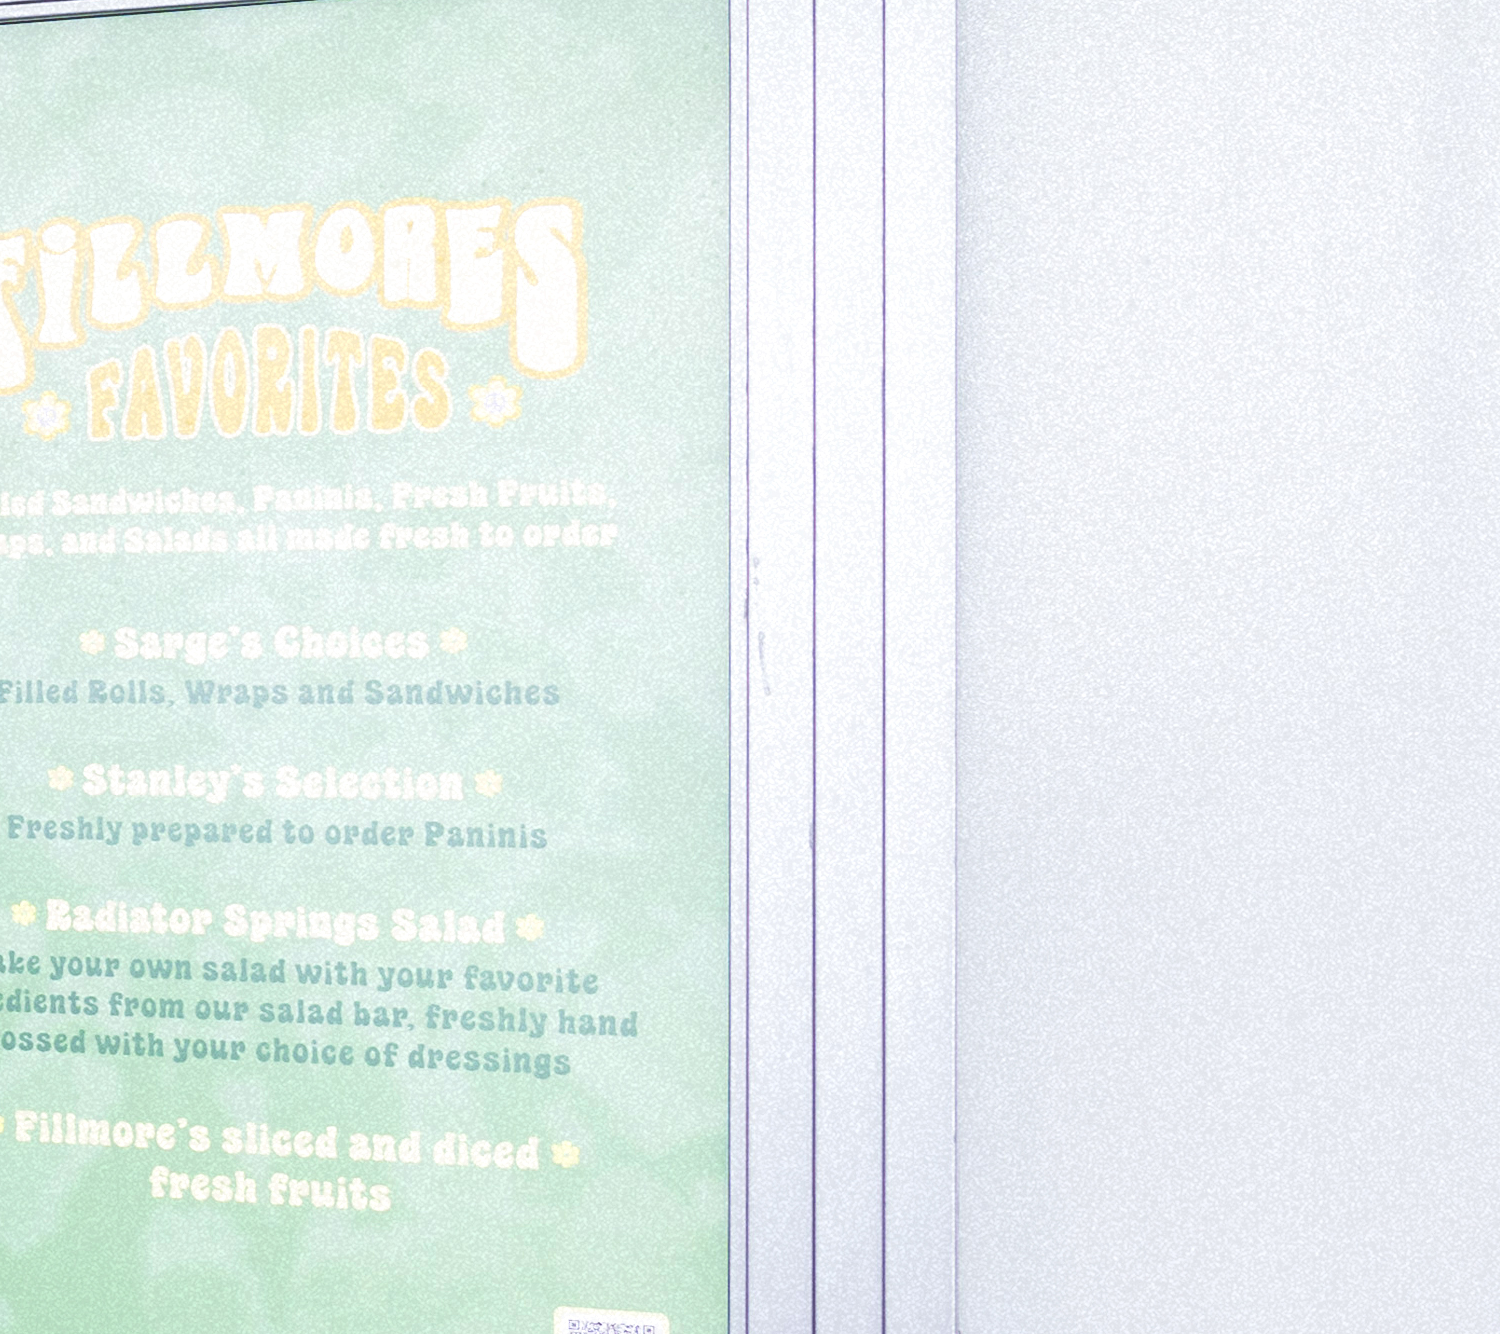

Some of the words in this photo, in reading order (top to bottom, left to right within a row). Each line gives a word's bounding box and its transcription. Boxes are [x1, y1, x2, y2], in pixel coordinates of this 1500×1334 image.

[85, 322, 453, 442] FAVORITES
[392, 481, 488, 509] Fresh
[61, 528, 115, 554] and
[124, 525, 228, 553] Salads
[236, 524, 277, 552] all
[286, 524, 370, 551] made
[379, 522, 469, 549] fresh
[479, 521, 514, 547] to
[522, 519, 619, 548] order
[113, 625, 262, 664] Sarge's
[273, 625, 429, 659] Choices
[87, 679, 176, 708] Rolls,
[183, 679, 288, 708] Wraps
[298, 679, 354, 705] and
[364, 678, 561, 706] Sandwiches
[82, 764, 265, 803] Stanley's
[276, 766, 464, 800] Selection
[7, 814, 123, 846] Freshly
[132, 817, 273, 846] prepared
[284, 819, 315, 845] to
[325, 819, 414, 847] order
[425, 822, 548, 850] Paninis
[45, 897, 213, 936] Radiator
[223, 902, 379, 946] Springs
[391, 906, 505, 944] Salad
[50, 955, 119, 981] your
[128, 956, 192, 981] own
[202, 957, 286, 984] salad
[295, 960, 368, 988] with
[377, 966, 453, 993] your
[463, 964, 599, 995] favorite
[108, 991, 185, 1021] from
[194, 998, 249, 1024] our
[258, 997, 342, 1026] salad
[354, 1001, 416, 1032] bar,
[424, 1004, 548, 1038] freshly
[557, 1009, 638, 1039] hand
[95, 1028, 164, 1058] with
[173, 1035, 246, 1063] your
[255, 1036, 354, 1066] choice
[364, 1041, 399, 1069] of
[408, 1042, 571, 1078] dressings
[14, 1109, 211, 1152] Fillmore's
[221, 1120, 338, 1159] sliced
[348, 1130, 421, 1164] and
[432, 1131, 540, 1170] diced
[149, 1165, 258, 1204] fresh
[268, 1171, 391, 1211] fruits
